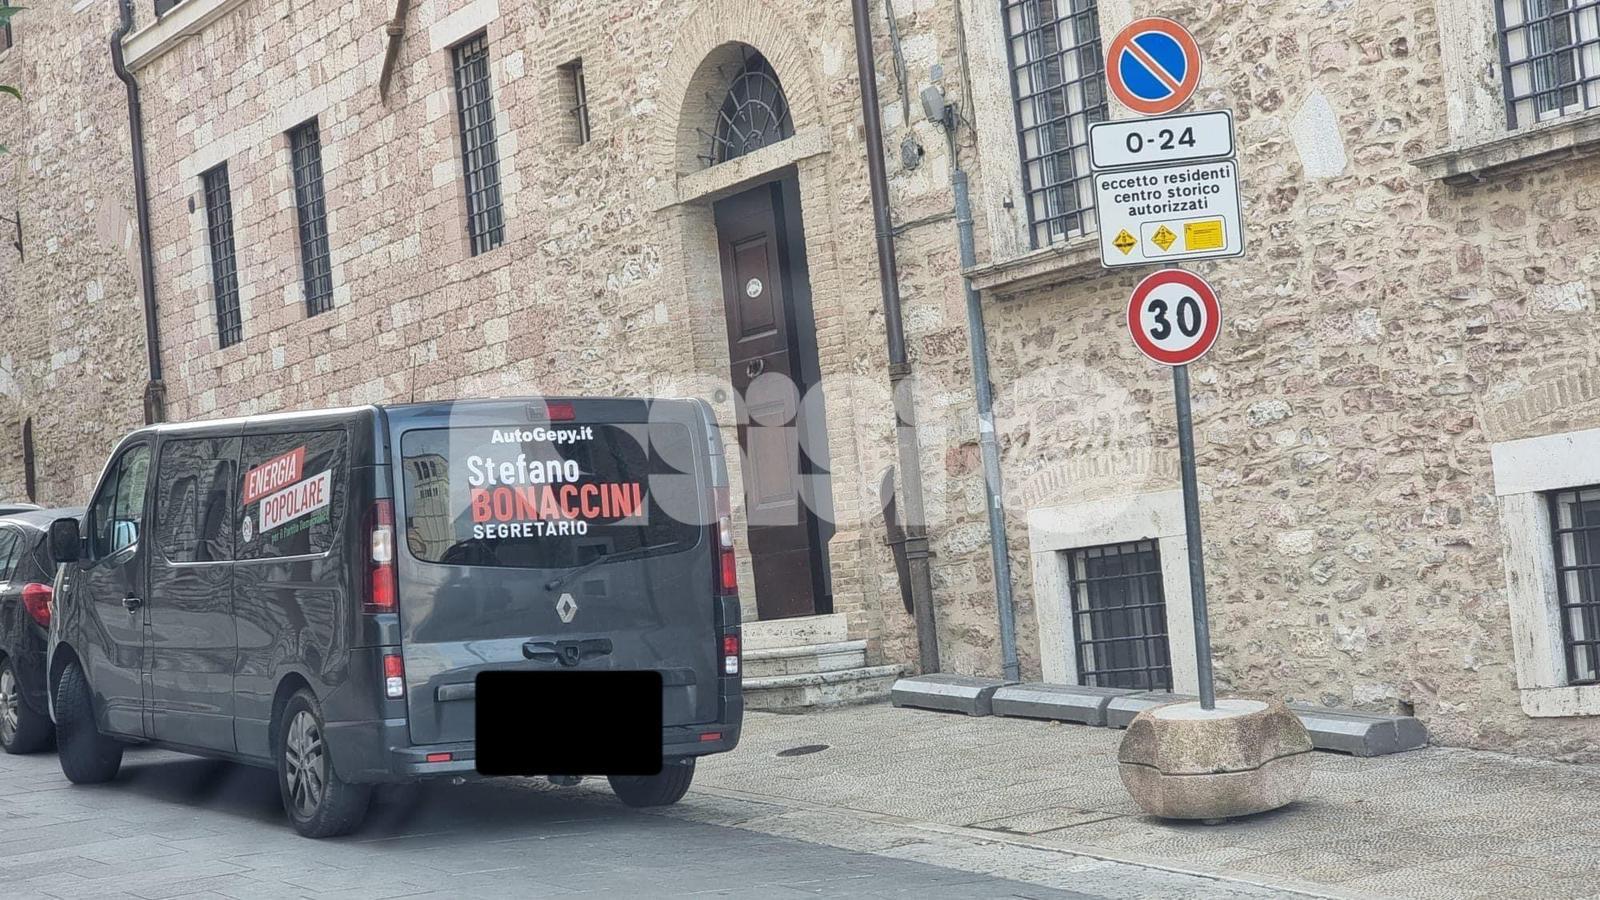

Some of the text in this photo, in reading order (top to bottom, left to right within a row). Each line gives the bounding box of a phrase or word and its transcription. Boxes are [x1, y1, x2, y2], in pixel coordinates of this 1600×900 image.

[1126, 127, 1196, 153] 0-24
[1102, 166, 1230, 190] eccetto residenti
[1114, 183, 1220, 203] centro storico
[1128, 197, 1208, 216] autorizzati
[1148, 296, 1202, 340] 30
[491, 426, 594, 444] AutoGepy.it
[249, 453, 296, 499] ENERGIA
[467, 453, 580, 486] Stefano
[264, 476, 324, 527] POPOLARE
[471, 483, 642, 522] BONACCINI
[473, 520, 588, 540] SEGRETARIO
